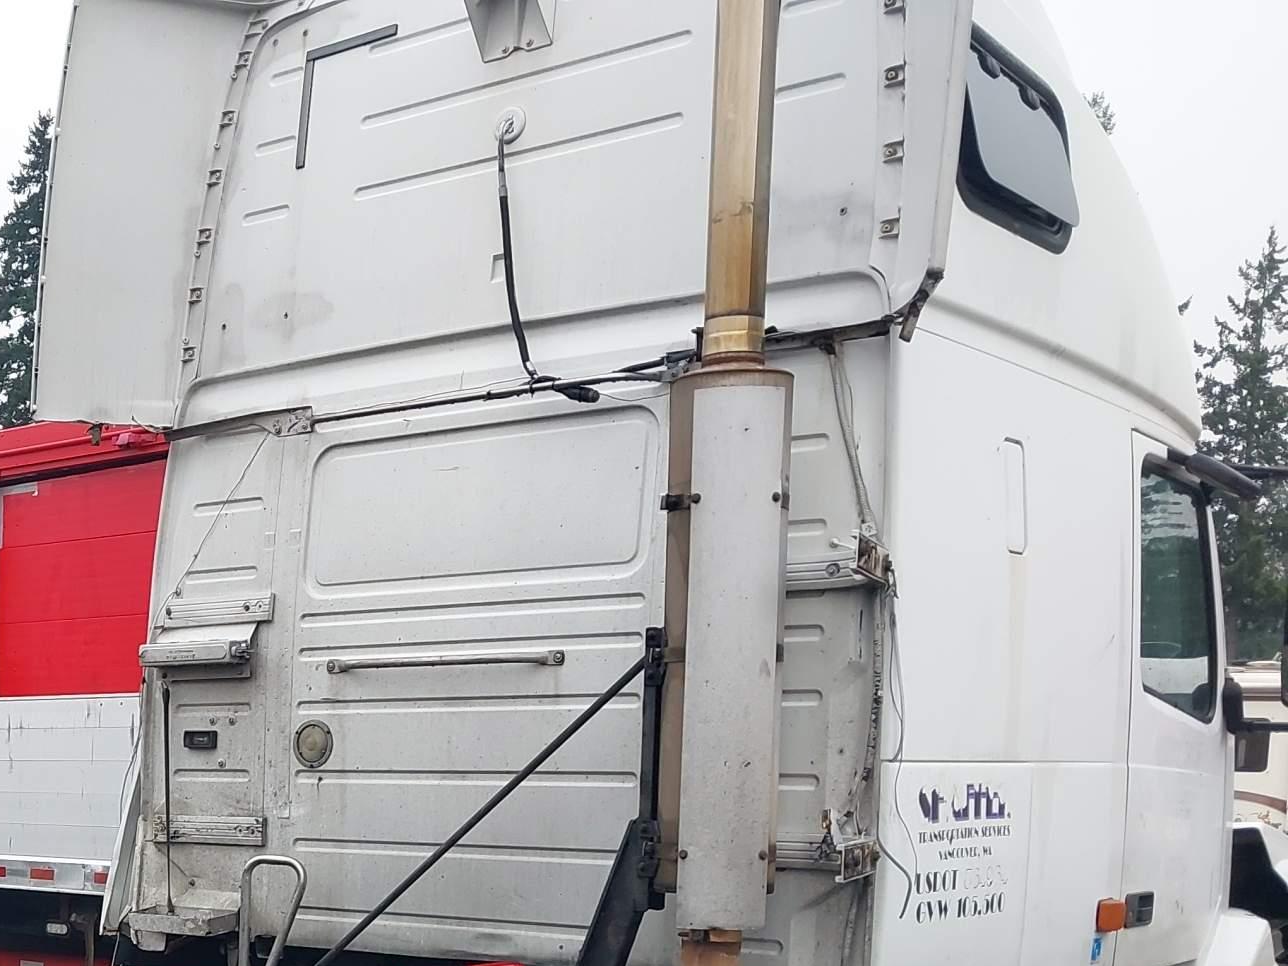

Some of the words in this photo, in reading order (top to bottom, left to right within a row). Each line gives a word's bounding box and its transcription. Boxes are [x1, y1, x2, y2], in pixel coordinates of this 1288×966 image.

[980, 824, 1011, 838] SERVICES
[916, 869, 959, 895] USDOT
[916, 899, 952, 924] GVW
